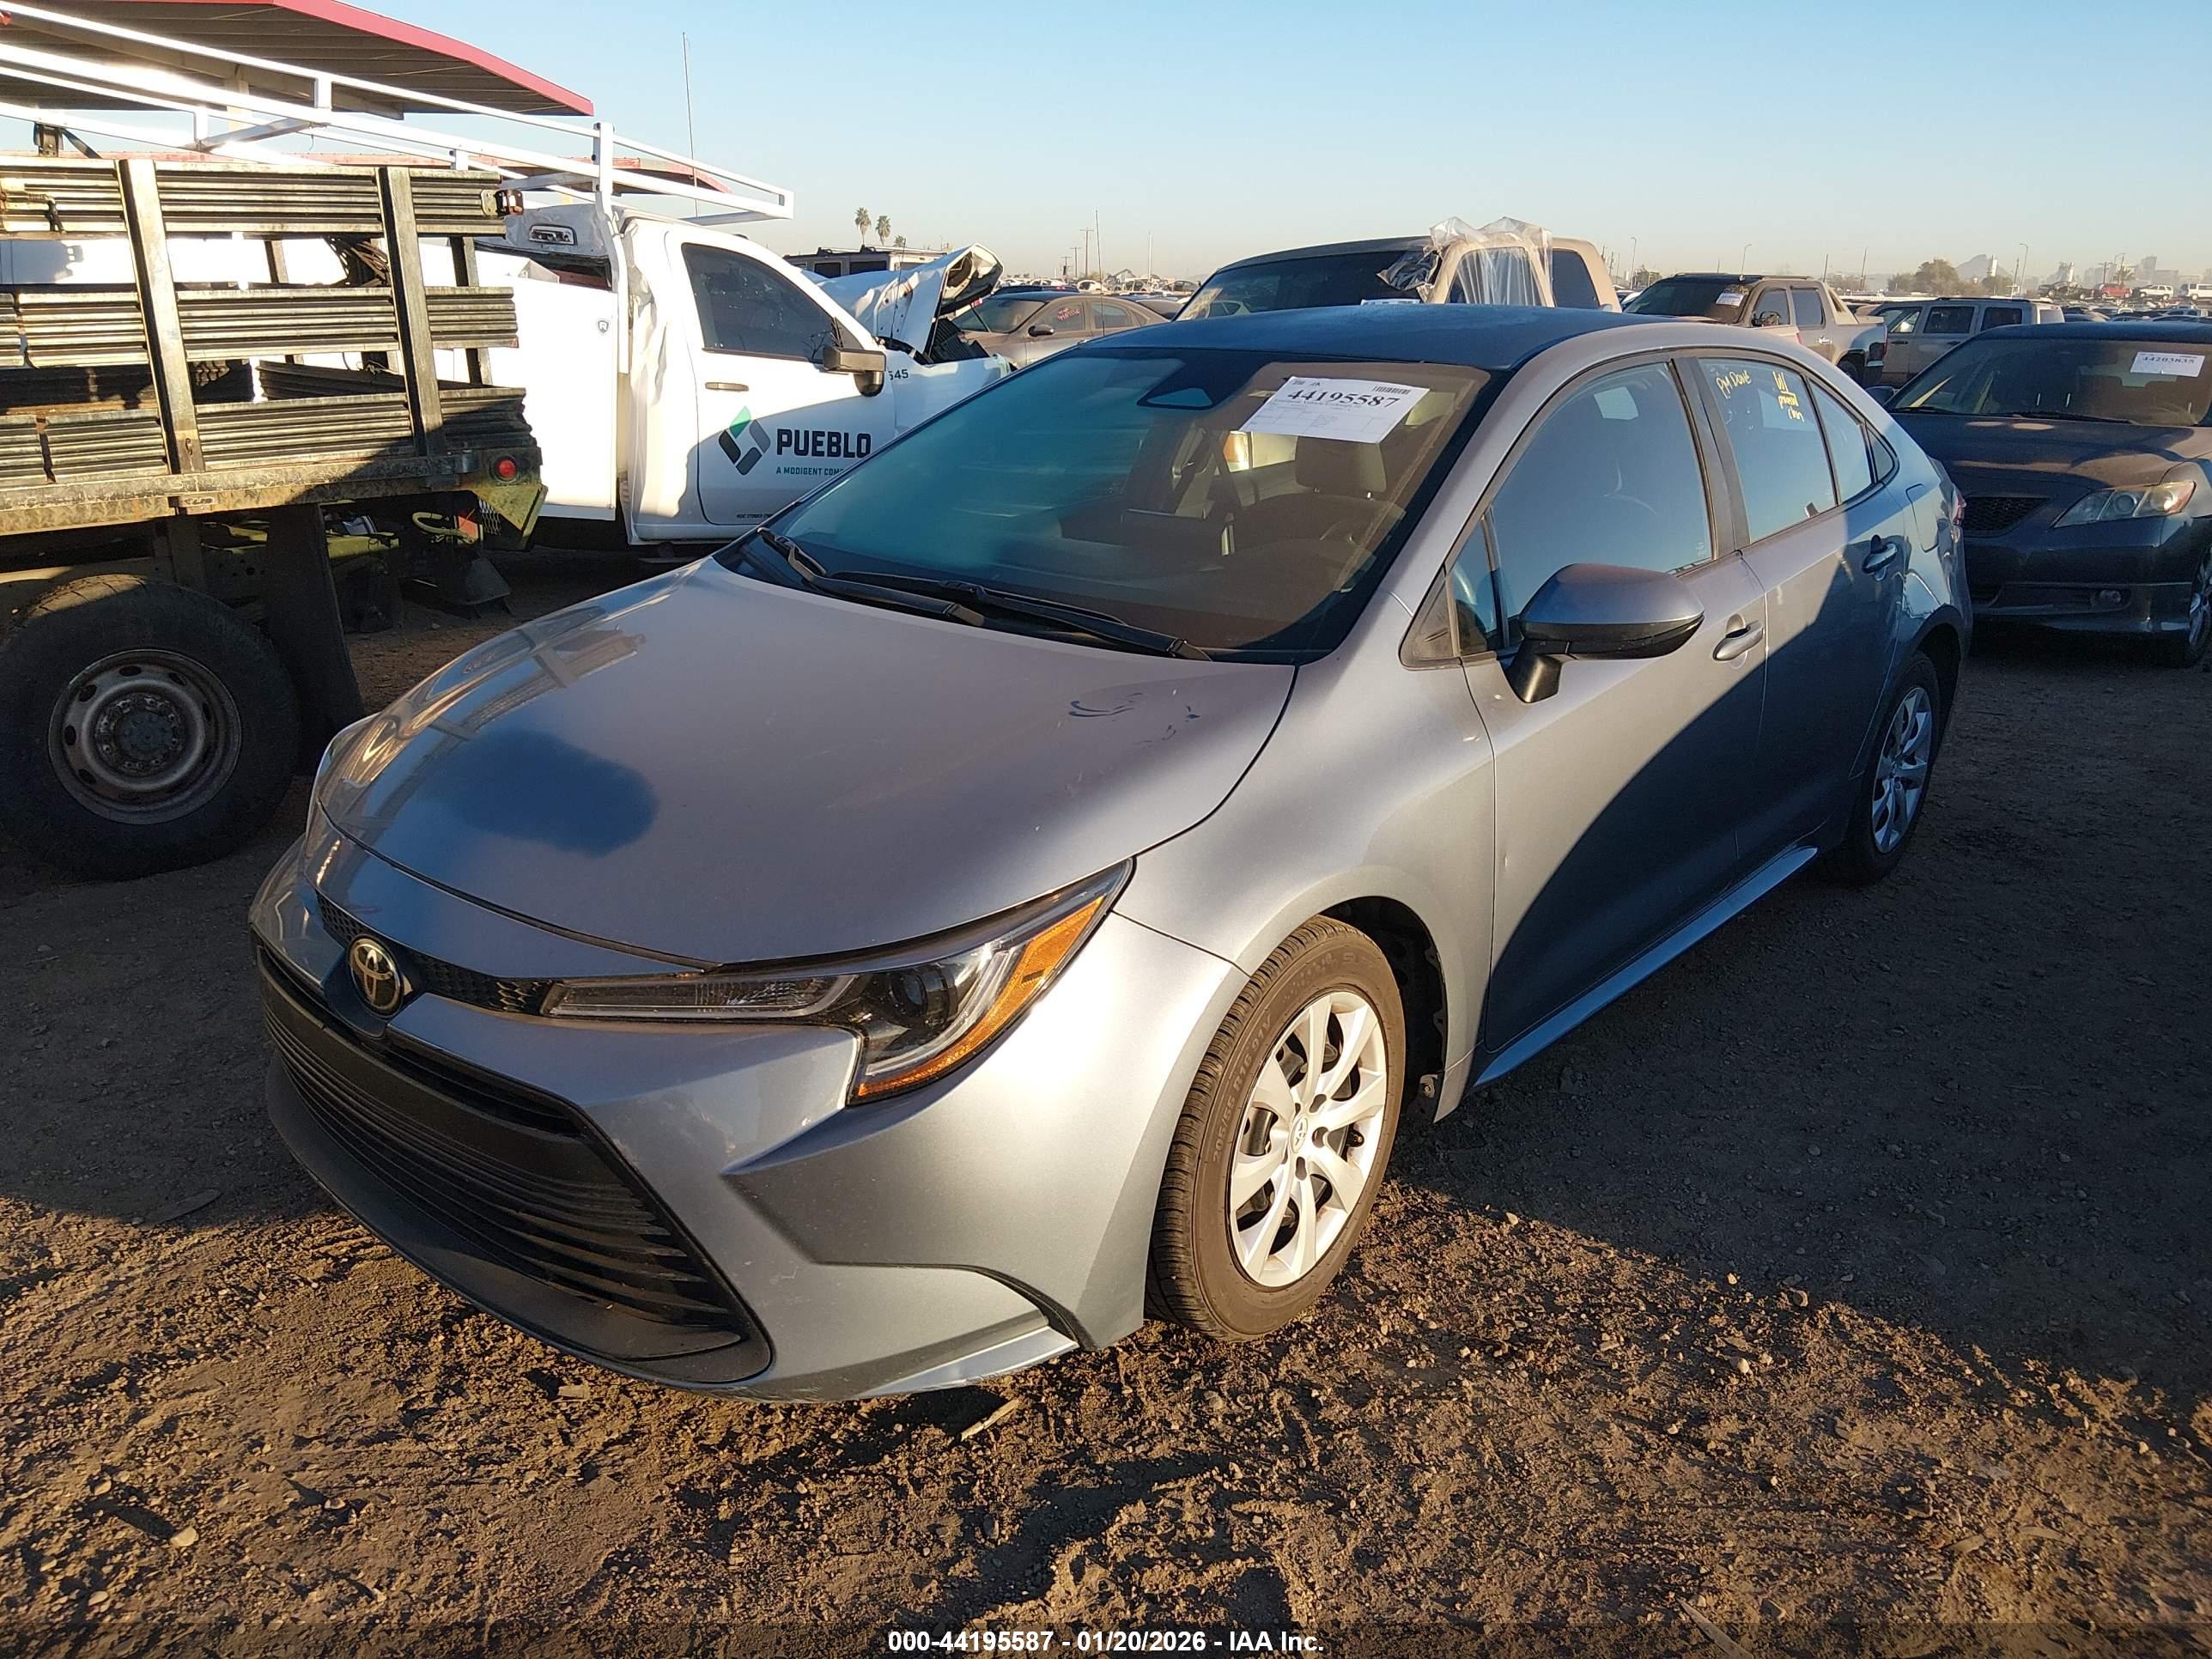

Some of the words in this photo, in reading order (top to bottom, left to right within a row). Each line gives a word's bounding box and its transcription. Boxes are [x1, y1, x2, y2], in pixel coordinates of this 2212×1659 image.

[1287, 389, 1401, 408] 44195587
[776, 428, 872, 459] PUEBLO
[775, 466, 782, 475] A
[783, 467, 823, 476] MODIGENT
